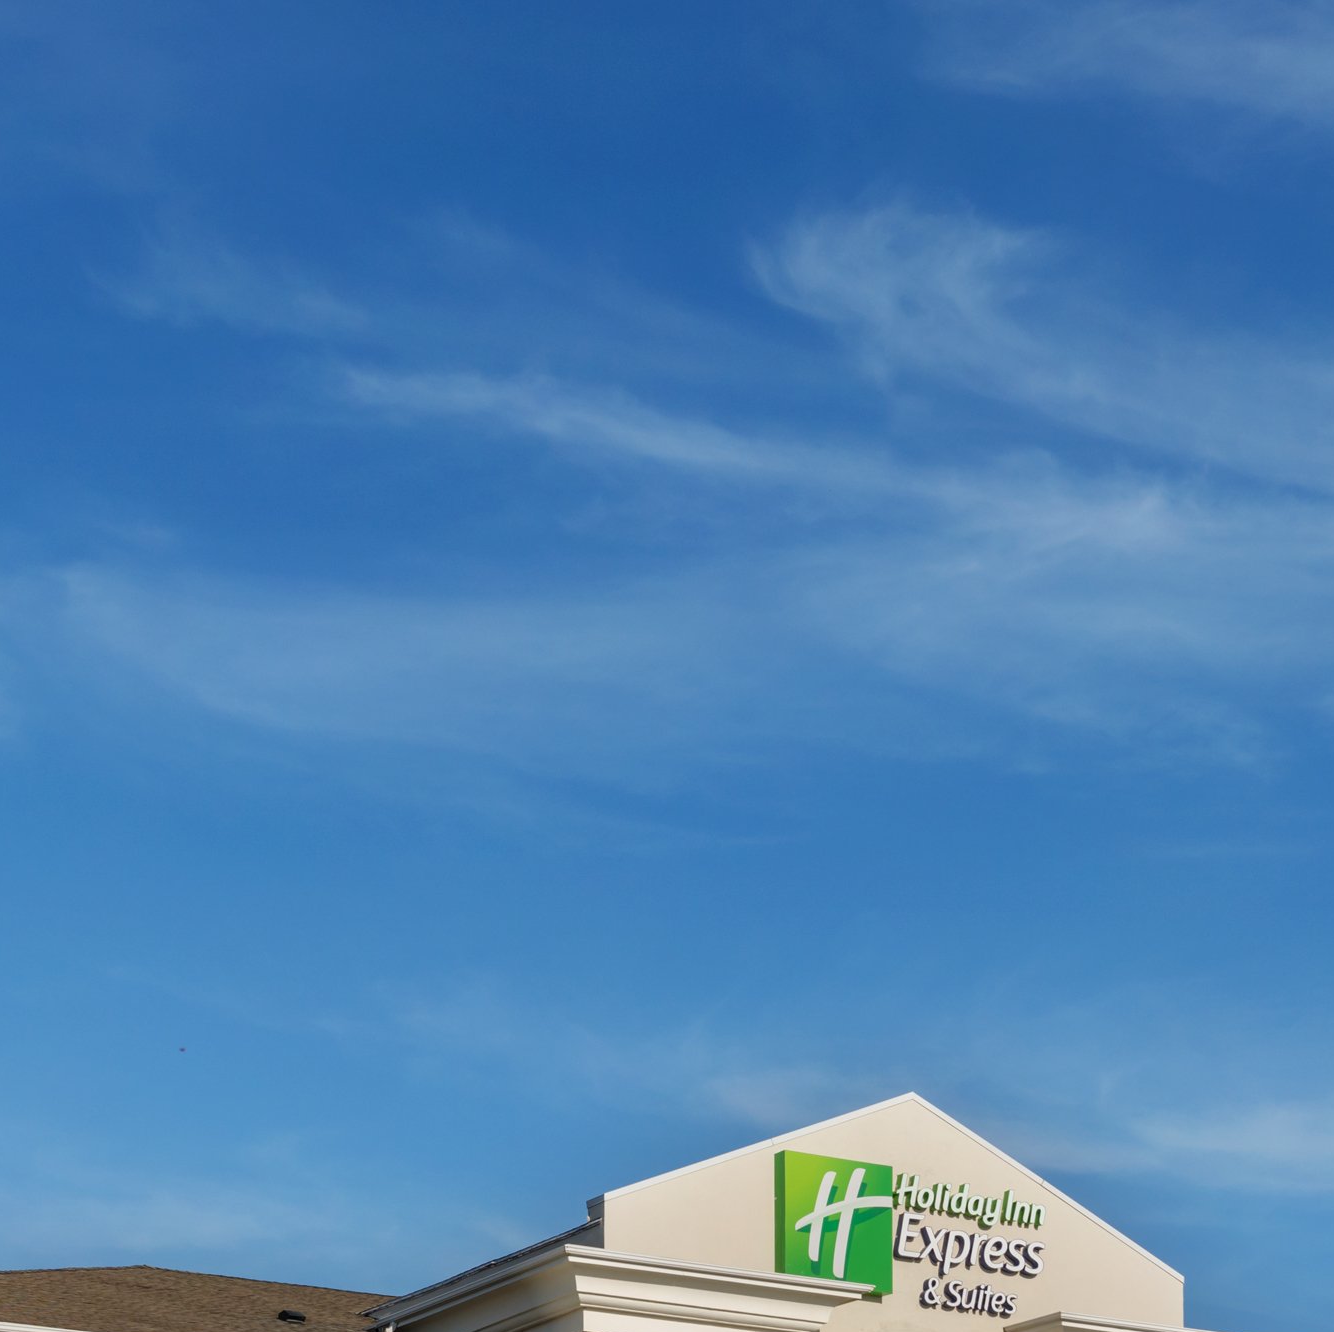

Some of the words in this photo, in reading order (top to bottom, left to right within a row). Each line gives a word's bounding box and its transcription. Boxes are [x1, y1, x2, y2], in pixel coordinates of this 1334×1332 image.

[895, 1172, 1002, 1228] Holiday
[1004, 1188, 1046, 1228] Inn
[894, 1212, 1046, 1277] Express
[920, 1277, 942, 1308] &
[944, 1279, 1018, 1318] Suites
